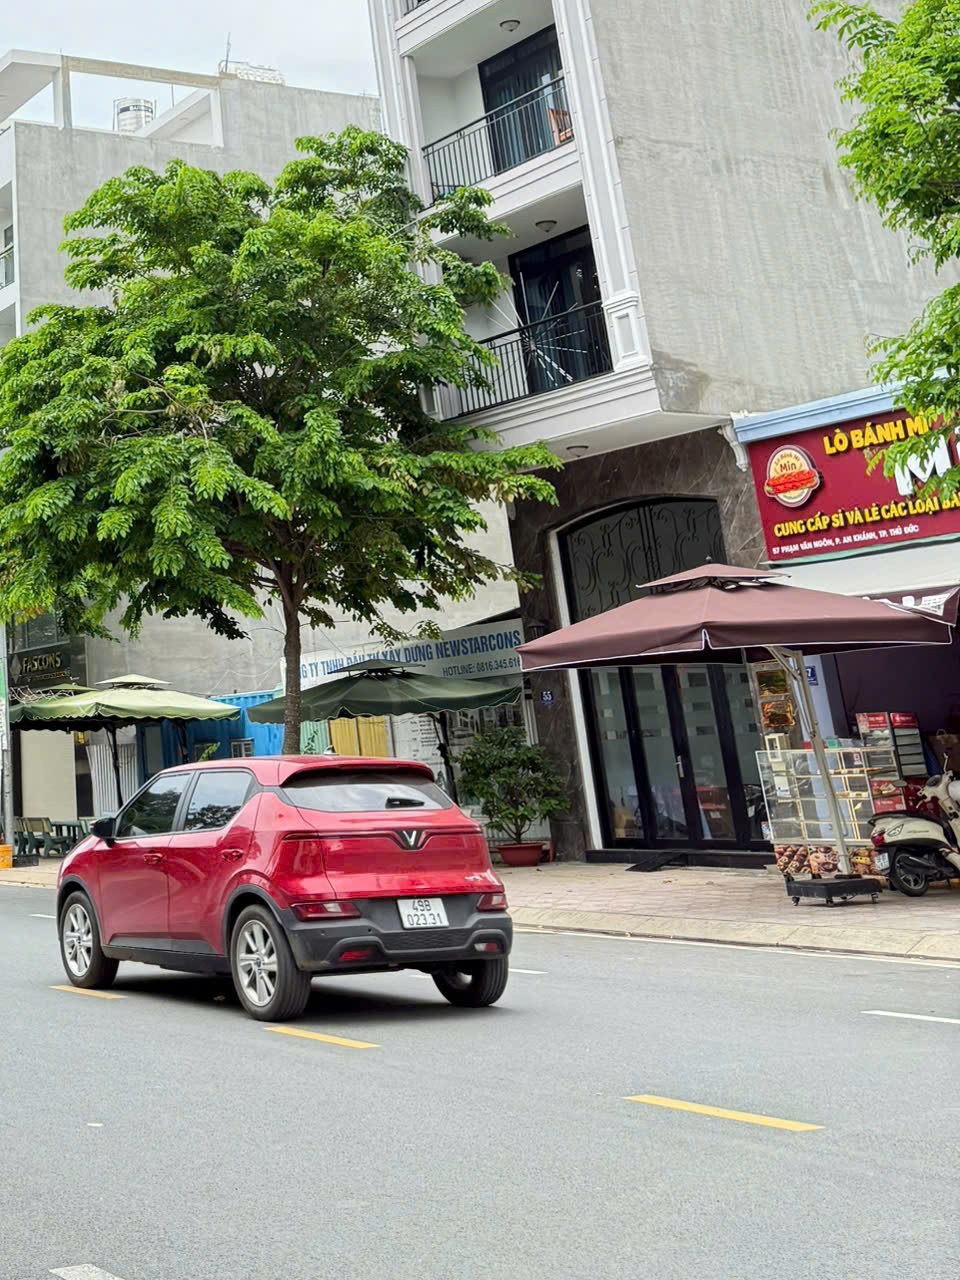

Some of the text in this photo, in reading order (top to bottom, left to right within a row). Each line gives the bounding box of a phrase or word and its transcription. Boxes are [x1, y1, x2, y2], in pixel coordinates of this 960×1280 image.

[823, 428, 848, 455] LÒ
[850, 422, 906, 449] BÁNH
[773, 519, 806, 537] CUNG
[806, 511, 830, 532] CẤP
[845, 506, 863, 525] VÀ
[881, 500, 907, 519] CÁC
[908, 496, 940, 515] LOẠI
[435, 630, 521, 659] NEWSTARCONS
[22, 651, 61, 673] FASCONS
[442, 663, 476, 677] HOTLINE:
[542, 691, 552, 700] 55
[412, 899, 432, 912] 49B
[407, 913, 443, 926] 023.31
